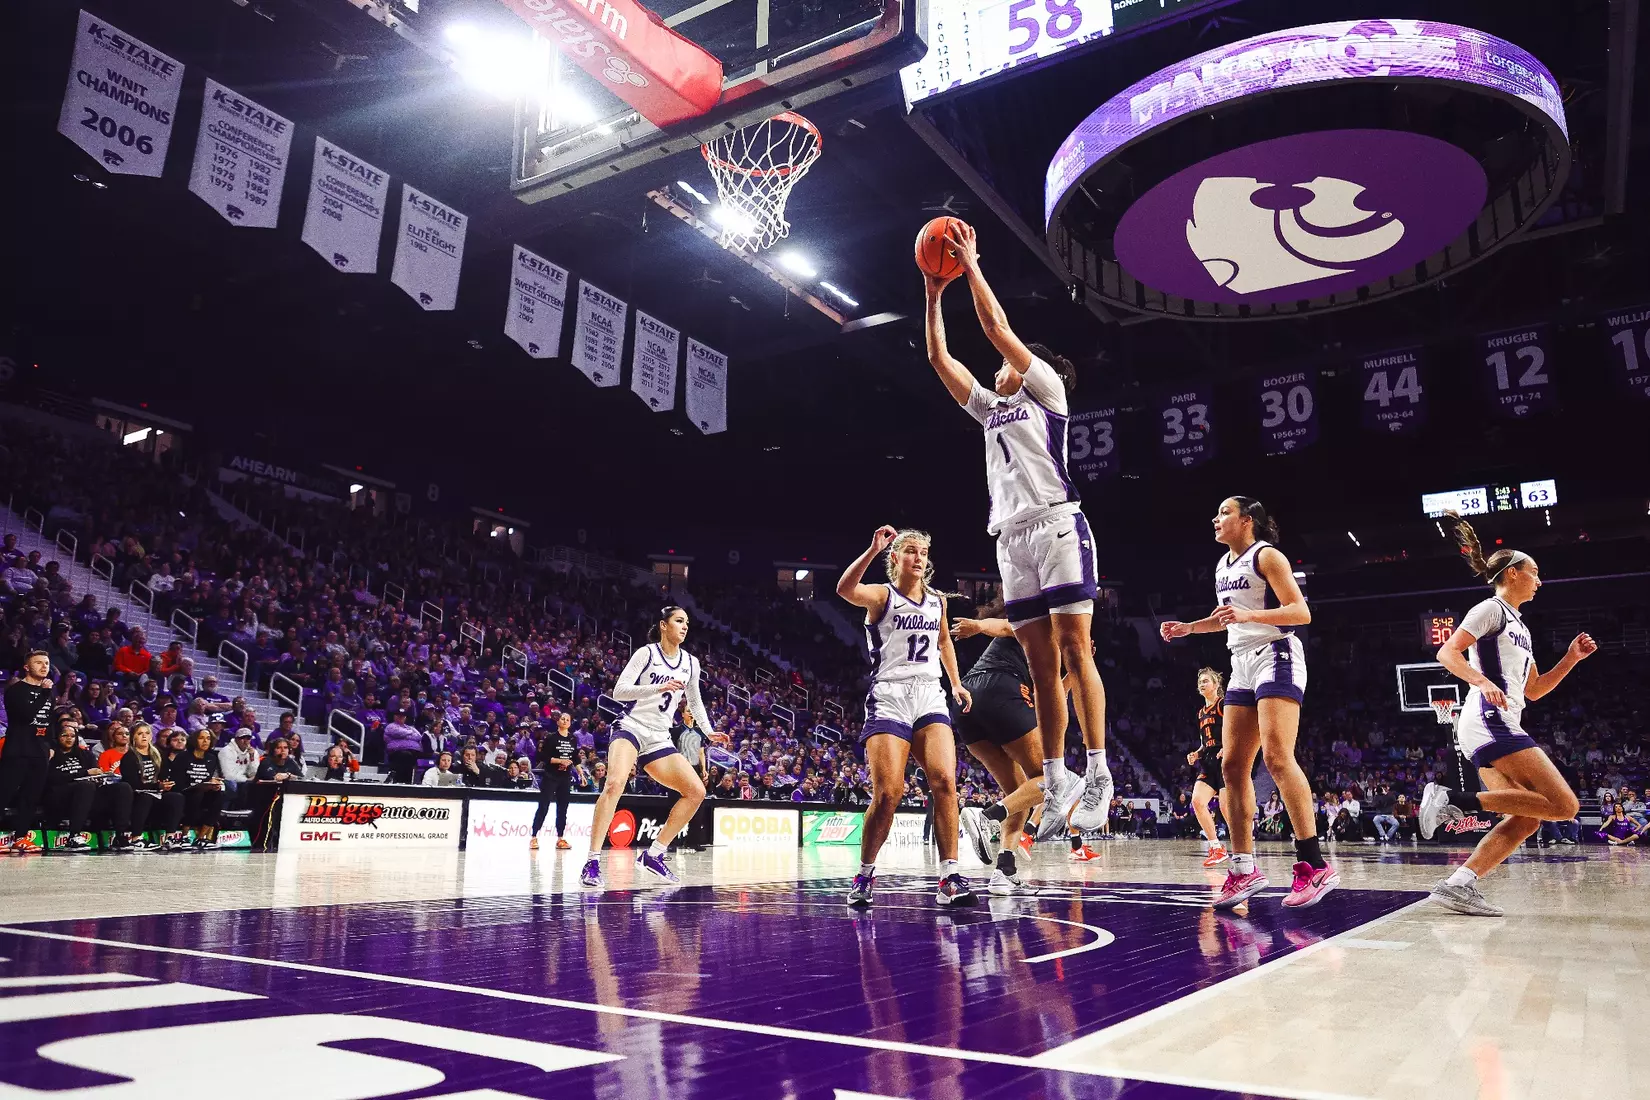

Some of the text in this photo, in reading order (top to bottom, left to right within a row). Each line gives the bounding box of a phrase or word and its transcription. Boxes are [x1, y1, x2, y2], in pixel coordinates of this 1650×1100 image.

[1009, 0, 1083, 55] 58
[88, 23, 176, 76] K-STATE
[937, 45, 949, 56] 12
[938, 58, 950, 70] 23
[107, 68, 148, 97] WNIT
[915, 80, 926, 90] 12
[939, 71, 950, 82] 11
[77, 70, 170, 125] CHAMPIONS
[213, 89, 286, 134] K-STATE
[80, 107, 153, 154] 2006
[208, 124, 281, 165] CHAMPIONSHIPS
[219, 120, 275, 153] CONFERENCE
[214, 153, 270, 186] 1977 1983
[215, 143, 271, 176] 1976 1982
[323, 146, 383, 185] K-STATE
[210, 175, 267, 206] 1979 1987
[212, 164, 269, 196] 1978 1984
[326, 175, 374, 204] CONFERENCE
[408, 193, 461, 227] K-STATE
[407, 224, 456, 253] ELITE EIGHT
[518, 252, 564, 282] K-STATE
[515, 278, 536, 296] SWEET
[537, 290, 564, 308] SIXTEEN
[583, 286, 623, 314] K-STATE
[591, 311, 613, 330] NCAA
[640, 316, 676, 342] K-STATE
[647, 340, 666, 357] NCAA
[1487, 331, 1538, 348] KRUGER
[1611, 328, 1650, 371] 1
[691, 344, 724, 366] K-STATE
[1364, 353, 1417, 369] MURRELL
[1486, 345, 1549, 390] 12
[1263, 372, 1305, 387] BOOZER
[1364, 366, 1423, 407] 44
[1171, 392, 1197, 404] PARR
[1261, 385, 1313, 427] 30
[1500, 391, 1541, 405] 1971-74
[1163, 403, 1211, 444] 33
[1376, 410, 1414, 421] 1962-64
[1071, 421, 1114, 460] 33
[1272, 428, 1307, 439] 1956-59
[996, 432, 1010, 465] 1
[1171, 445, 1204, 456] 1955-58
[230, 455, 297, 484] AHEARN
[1078, 460, 1108, 472] 1950-53
[1461, 498, 1480, 510] 58
[1528, 490, 1548, 502] 63
[1432, 617, 1454, 628] 5:42
[1432, 628, 1452, 645] 30
[907, 633, 930, 663] 12
[658, 691, 673, 712] 3
[304, 795, 450, 824] Briggsauto.com
[300, 831, 341, 841] GMC
[719, 815, 792, 840] QDOBA
